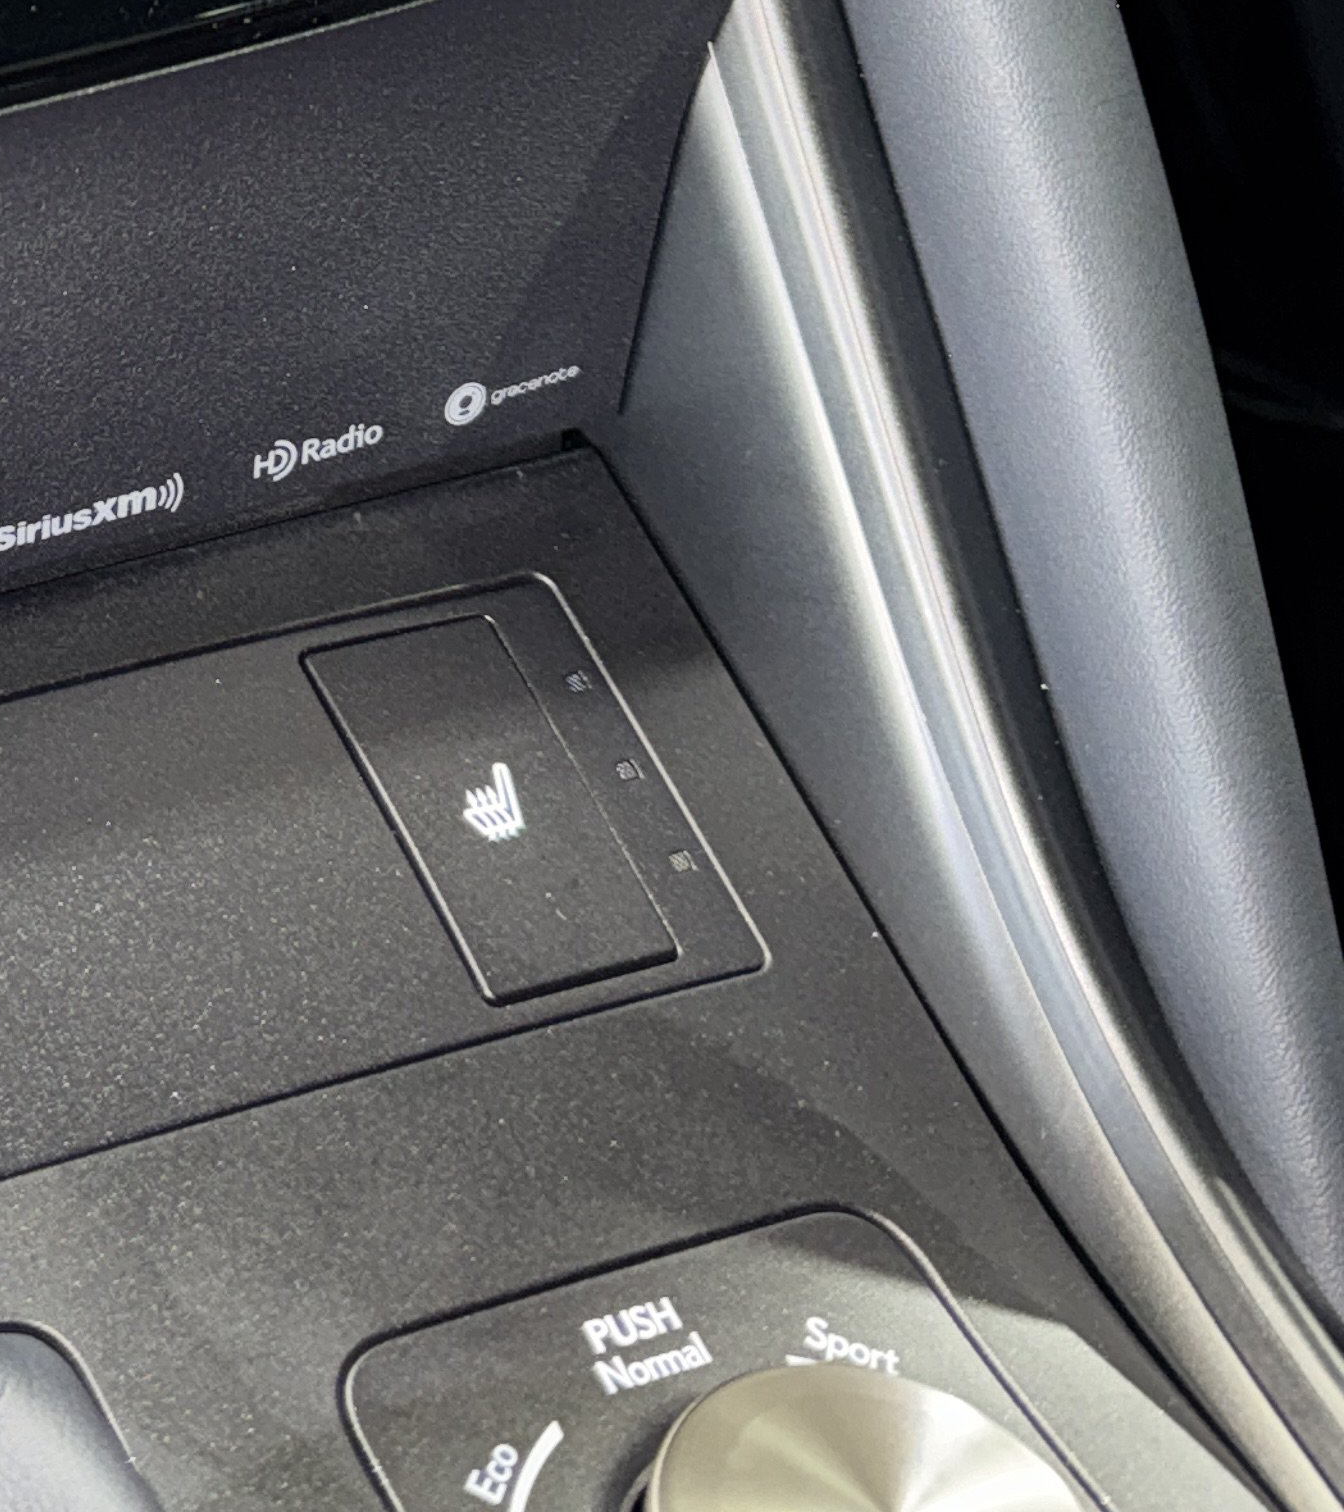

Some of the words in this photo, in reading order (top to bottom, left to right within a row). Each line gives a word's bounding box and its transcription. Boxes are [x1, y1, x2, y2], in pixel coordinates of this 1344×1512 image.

[253, 439, 298, 482] HD
[301, 423, 384, 465] Radio
[581, 1296, 684, 1355] PUSH
[802, 1316, 900, 1376] Sport
[592, 1330, 713, 1395] Normal
[465, 1443, 519, 1506] Eco
